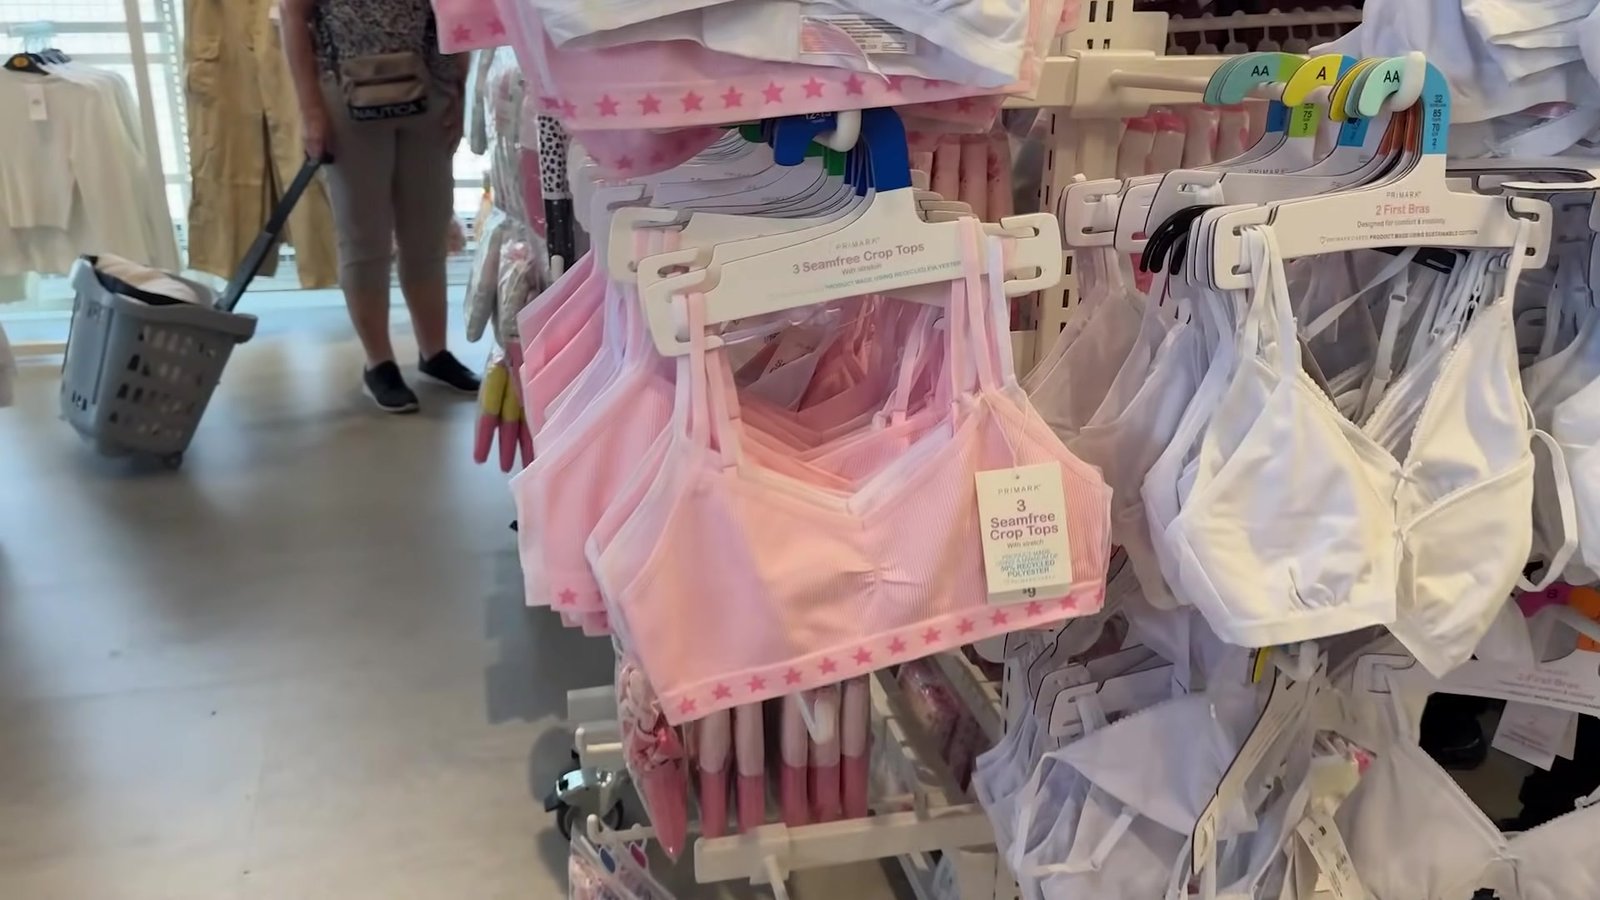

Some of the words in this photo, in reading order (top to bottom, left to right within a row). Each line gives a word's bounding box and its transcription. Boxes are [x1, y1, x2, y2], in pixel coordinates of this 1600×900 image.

[1250, 65, 1270, 77] AA
[1316, 66, 1327, 80] A
[1383, 70, 1401, 83] AA
[1303, 110, 1313, 118] 75
[1432, 108, 1441, 117] 85
[1385, 190, 1421, 199] PRIMARK
[1375, 204, 1381, 216] 2
[1384, 204, 1407, 215] First
[1408, 203, 1430, 214] Bras
[1357, 219, 1385, 229] Designed
[835, 237, 880, 250] PRIMARK
[792, 264, 801, 275] 3
[802, 255, 861, 273] Seamfree
[863, 249, 893, 263] Crop
[897, 242, 925, 256] Tops
[997, 484, 1041, 494] PRIMARK
[1016, 499, 1026, 512] 3
[990, 513, 1055, 528] Seamfree
[990, 528, 1023, 540] Crop
[1026, 525, 1059, 536] Tops
